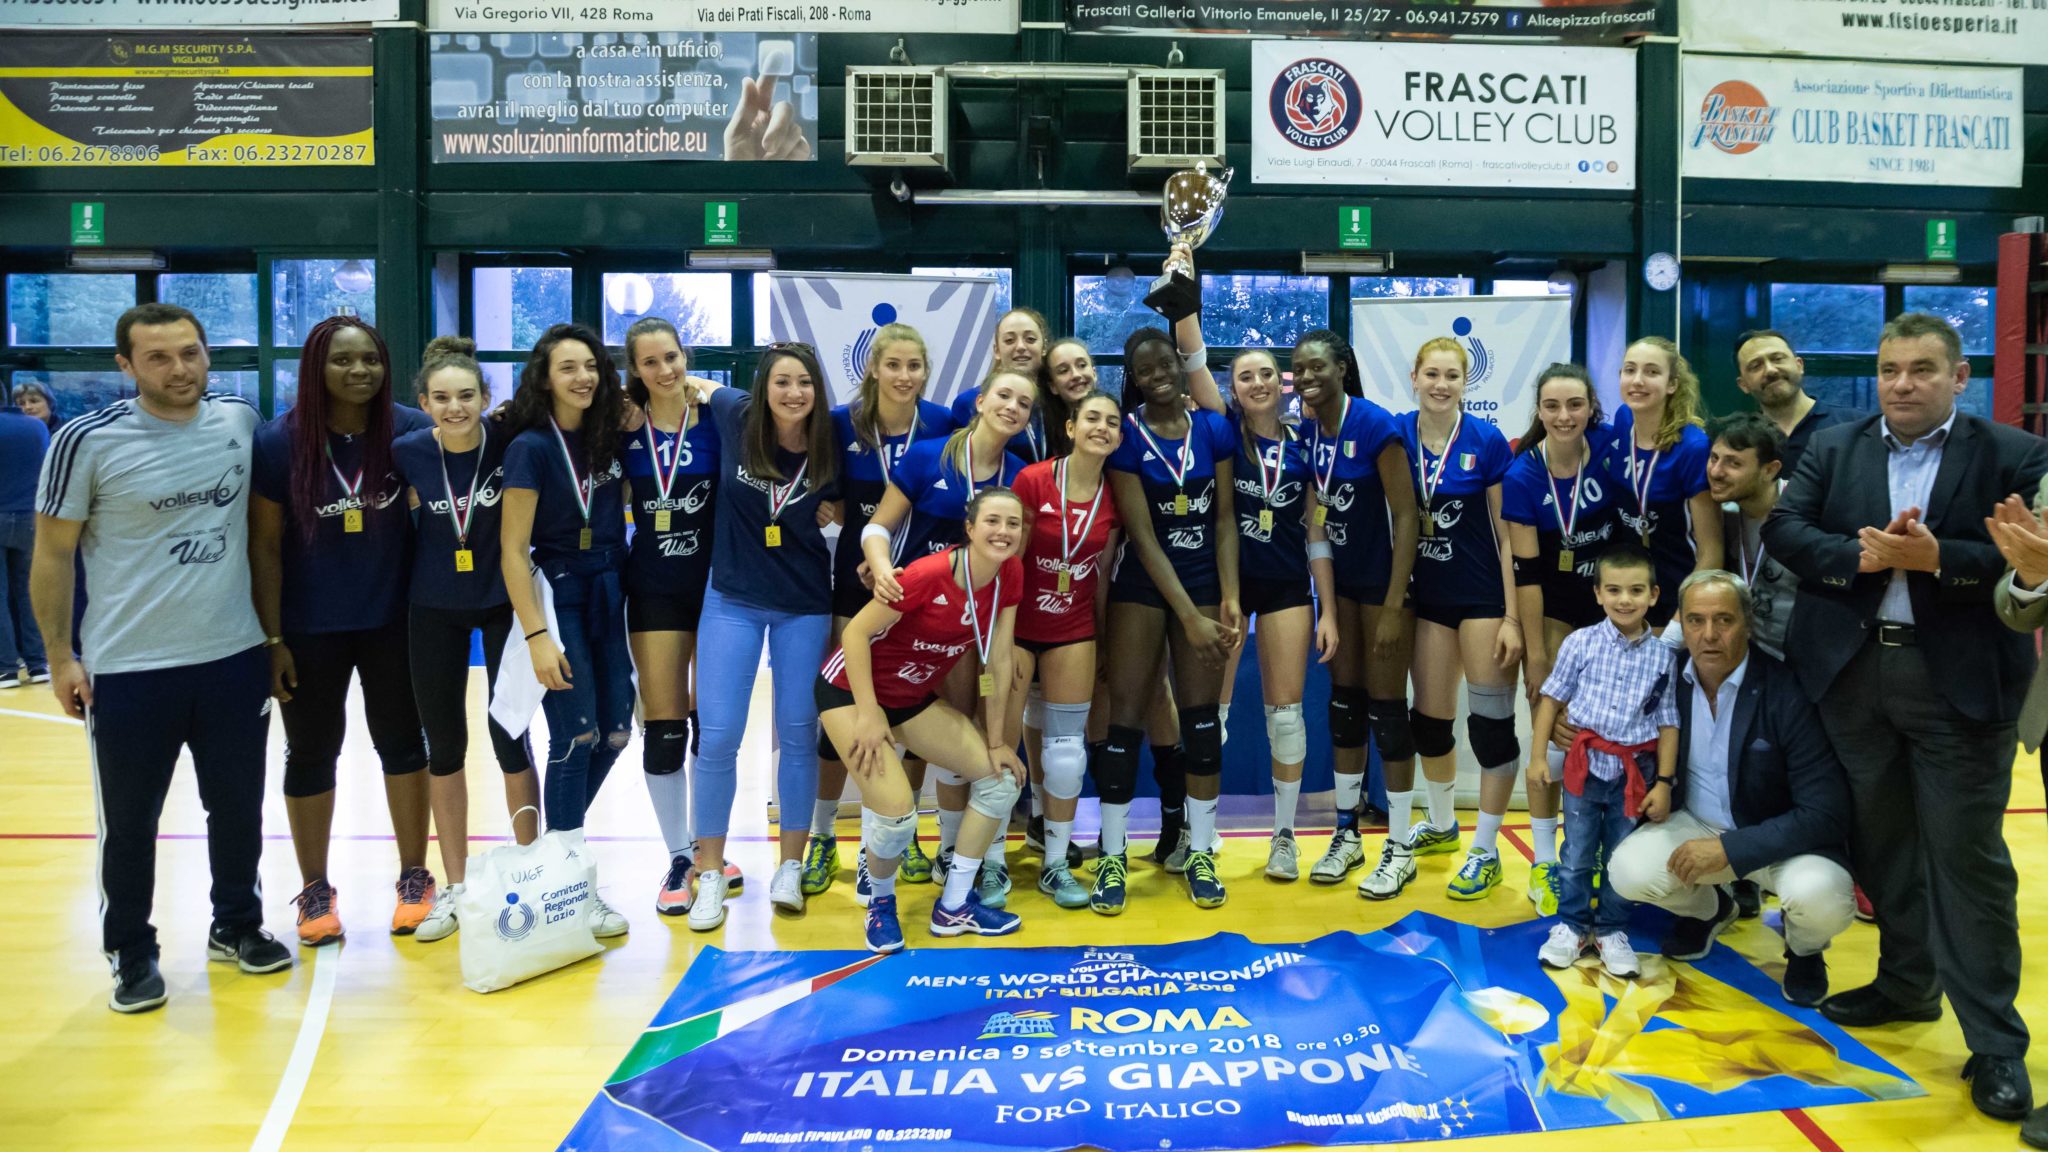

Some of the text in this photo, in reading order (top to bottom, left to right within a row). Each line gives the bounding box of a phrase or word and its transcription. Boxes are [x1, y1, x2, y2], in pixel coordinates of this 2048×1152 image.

[455, 7, 653, 22] Via Gregorio VII, 428 Roma
[698, 8, 715, 22] Via
[718, 8, 734, 22] dei
[738, 7, 763, 21] Prati
[767, 6, 806, 22] Fiscali,
[810, 6, 828, 20] 208
[839, 6, 872, 21] Roma
[1077, 5, 1131, 18] Frascati
[1136, 5, 1195, 19] Galleria
[1200, 6, 1252, 20] Vittorio
[1257, 7, 1329, 22] Emanuele,
[1344, 9, 1390, 25] 25/27
[1405, 11, 1499, 27] 06.941.7579
[1526, 9, 1655, 28] Alicepizzafrascati
[1842, 12, 2018, 34] www.fisioesperia.it
[135, 44, 170, 54] M.G.M
[173, 44, 224, 54] SECURITY
[227, 44, 256, 54] S.P.A.
[172, 56, 219, 64] VIGILANZA
[576, 40, 724, 61] a casa e in ufficio,
[523, 70, 729, 89] con la nostra assistenza,
[1284, 61, 1346, 82] FRASCATI
[1404, 71, 1587, 105] FRASCATI
[1792, 77, 2013, 101] Associazione Sportiva Dilettantistica
[458, 100, 729, 122] avrai il meglio dal tuo computer
[1701, 94, 1782, 123] BASKET
[1284, 125, 1348, 147] VOLLEY CLUB
[1374, 109, 1617, 145] VOLLEY CLUB
[1792, 108, 2011, 150] CLUB BASKET FRASCATI
[443, 127, 708, 155] www.soluzioninformatiche.eu
[0, 145, 161, 162] Tel: 06.2678806
[186, 144, 367, 161] Fax: 06.23270287
[1267, 157, 1291, 167] Viale
[1294, 158, 1315, 168] Luigi
[1317, 158, 1354, 168] Einaudi,
[1357, 159, 1363, 167] 7
[1370, 159, 1398, 167] 00044
[1400, 158, 1437, 168] Frascati
[1438, 159, 1473, 169] (Roma)
[1482, 159, 1570, 171] frascativolleyclub.it
[1869, 157, 1905, 171] SINCE
[656, 440, 693, 467] 16
[1071, 508, 1088, 535] 7
[960, 599, 978, 626] 8
[541, 880, 588, 902] Comitato
[544, 890, 589, 914] Regionale
[546, 908, 576, 925] Lazio
[906, 975, 991, 988] MEN'S
[1000, 973, 1098, 986] WORLD
[985, 982, 1236, 1000] ITALY-BULGARIA 2018
[1070, 1006, 1253, 1034] ROMA
[841, 1023, 1381, 1064] Domenica 9 settembre 2018 ore 19.30
[792, 1068, 998, 1098] ITALIA
[1108, 1042, 1429, 1090] GIAPPONE
[996, 1099, 1242, 1124] FORO ITALICO
[1286, 1110, 1344, 1127] Biglietti
[1345, 1112, 1365, 1125] su
[804, 1128, 873, 1143] FIPAVLAZIO
